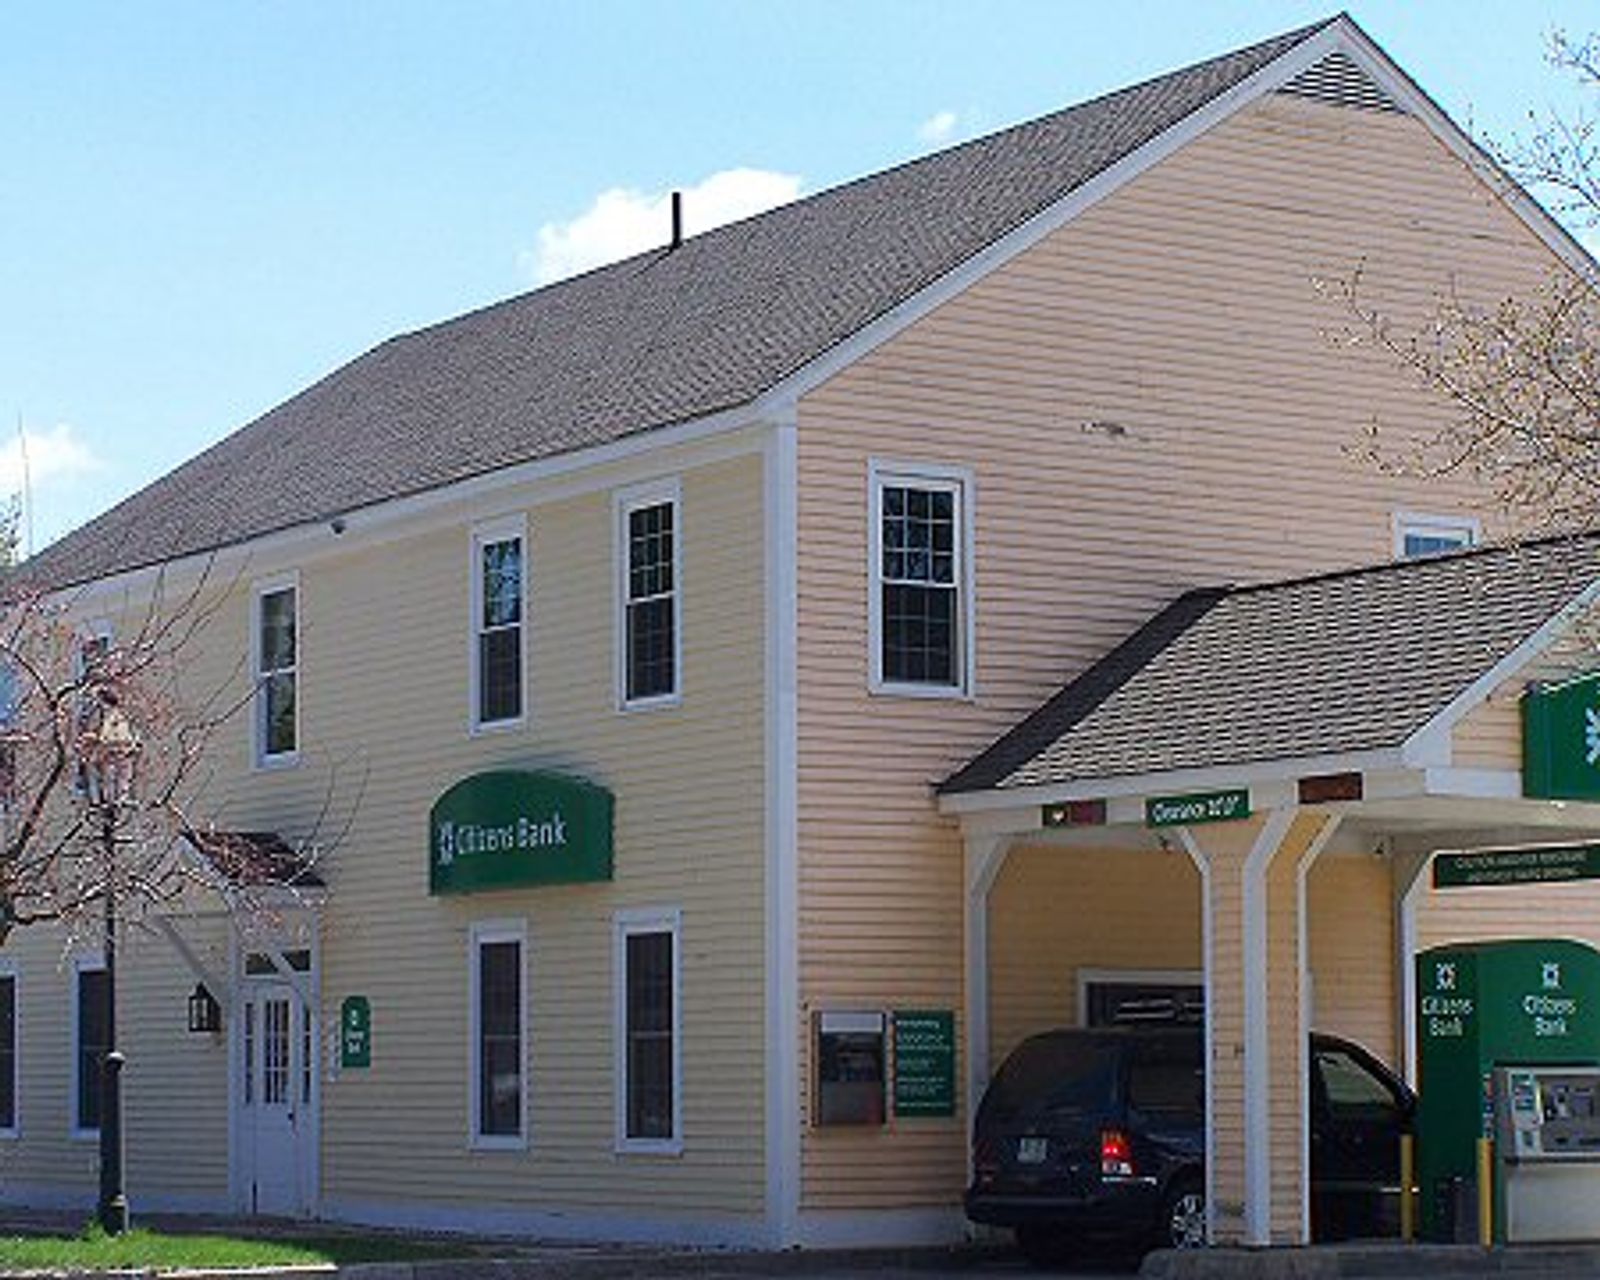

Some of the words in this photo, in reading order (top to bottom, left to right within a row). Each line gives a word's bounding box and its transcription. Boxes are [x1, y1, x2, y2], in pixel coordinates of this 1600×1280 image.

[457, 822, 514, 856] Citizens
[518, 811, 567, 848] Bank
[1421, 996, 1474, 1015] Citizens
[1522, 995, 1577, 1015] Citizens
[1429, 1016, 1464, 1037] Bank
[1535, 1016, 1569, 1037] Bank
